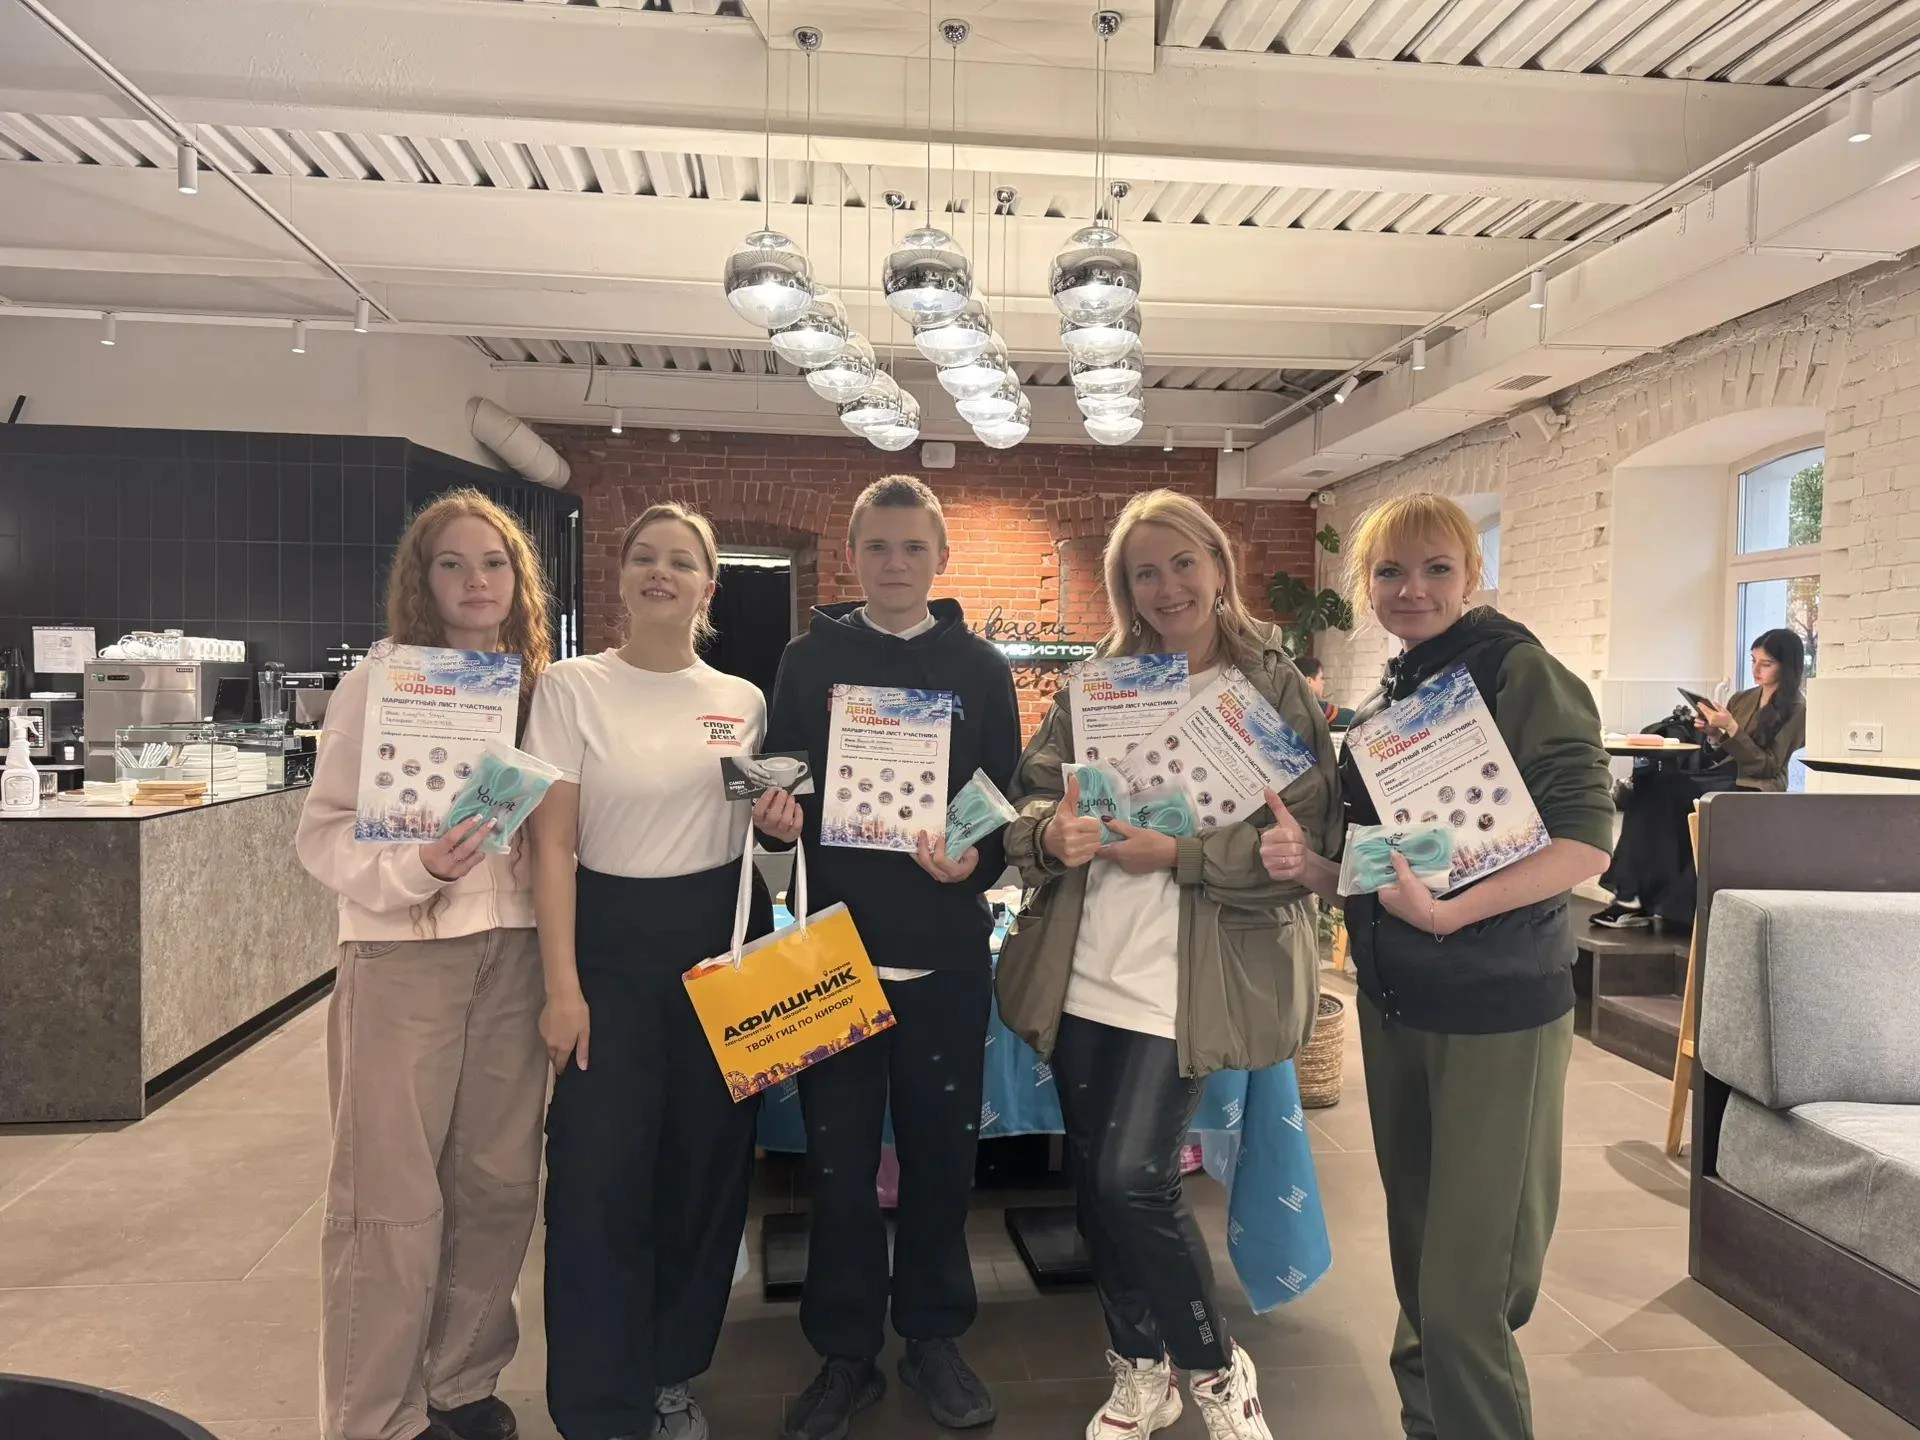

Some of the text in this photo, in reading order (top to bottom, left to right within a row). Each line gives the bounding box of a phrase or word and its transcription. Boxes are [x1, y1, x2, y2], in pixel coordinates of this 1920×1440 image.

[994, 644, 1097, 655] ИСТОР
[387, 671, 426, 681] ДЕНЬ
[394, 683, 456, 696] ХОДЬБЫ
[1083, 682, 1112, 692] ДЕНЬ
[382, 697, 436, 707] МАРШРУТНЫЙ
[1090, 690, 1137, 701] ХОДЬБЫ
[846, 706, 876, 715] ДЕНЬ
[1082, 704, 1124, 712] МАРШРУТНЫЙ
[1218, 692, 1244, 720] ДЕНЬ
[852, 716, 900, 726] ХОДЬБЫ
[1215, 704, 1256, 746] ХОДЬБЫ
[1201, 706, 1233, 742] МАРШРУТНЫЙ
[1232, 740, 1245, 754] ЛИСТ
[1244, 754, 1271, 784] УЧАСТНИКА
[1368, 735, 1401, 757] ДЕНЬ
[1375, 750, 1419, 777] МАРШРУТНЫЙ
[1421, 741, 1437, 753] ЛИСТ
[1438, 719, 1477, 743] УЧАСТНИКА
[1379, 728, 1431, 762] ХОДЬБЫ
[724, 967, 858, 1042] АФИШНИК
[746, 995, 854, 1053] ТВОЙ ГИД ПО КИРОВУ
